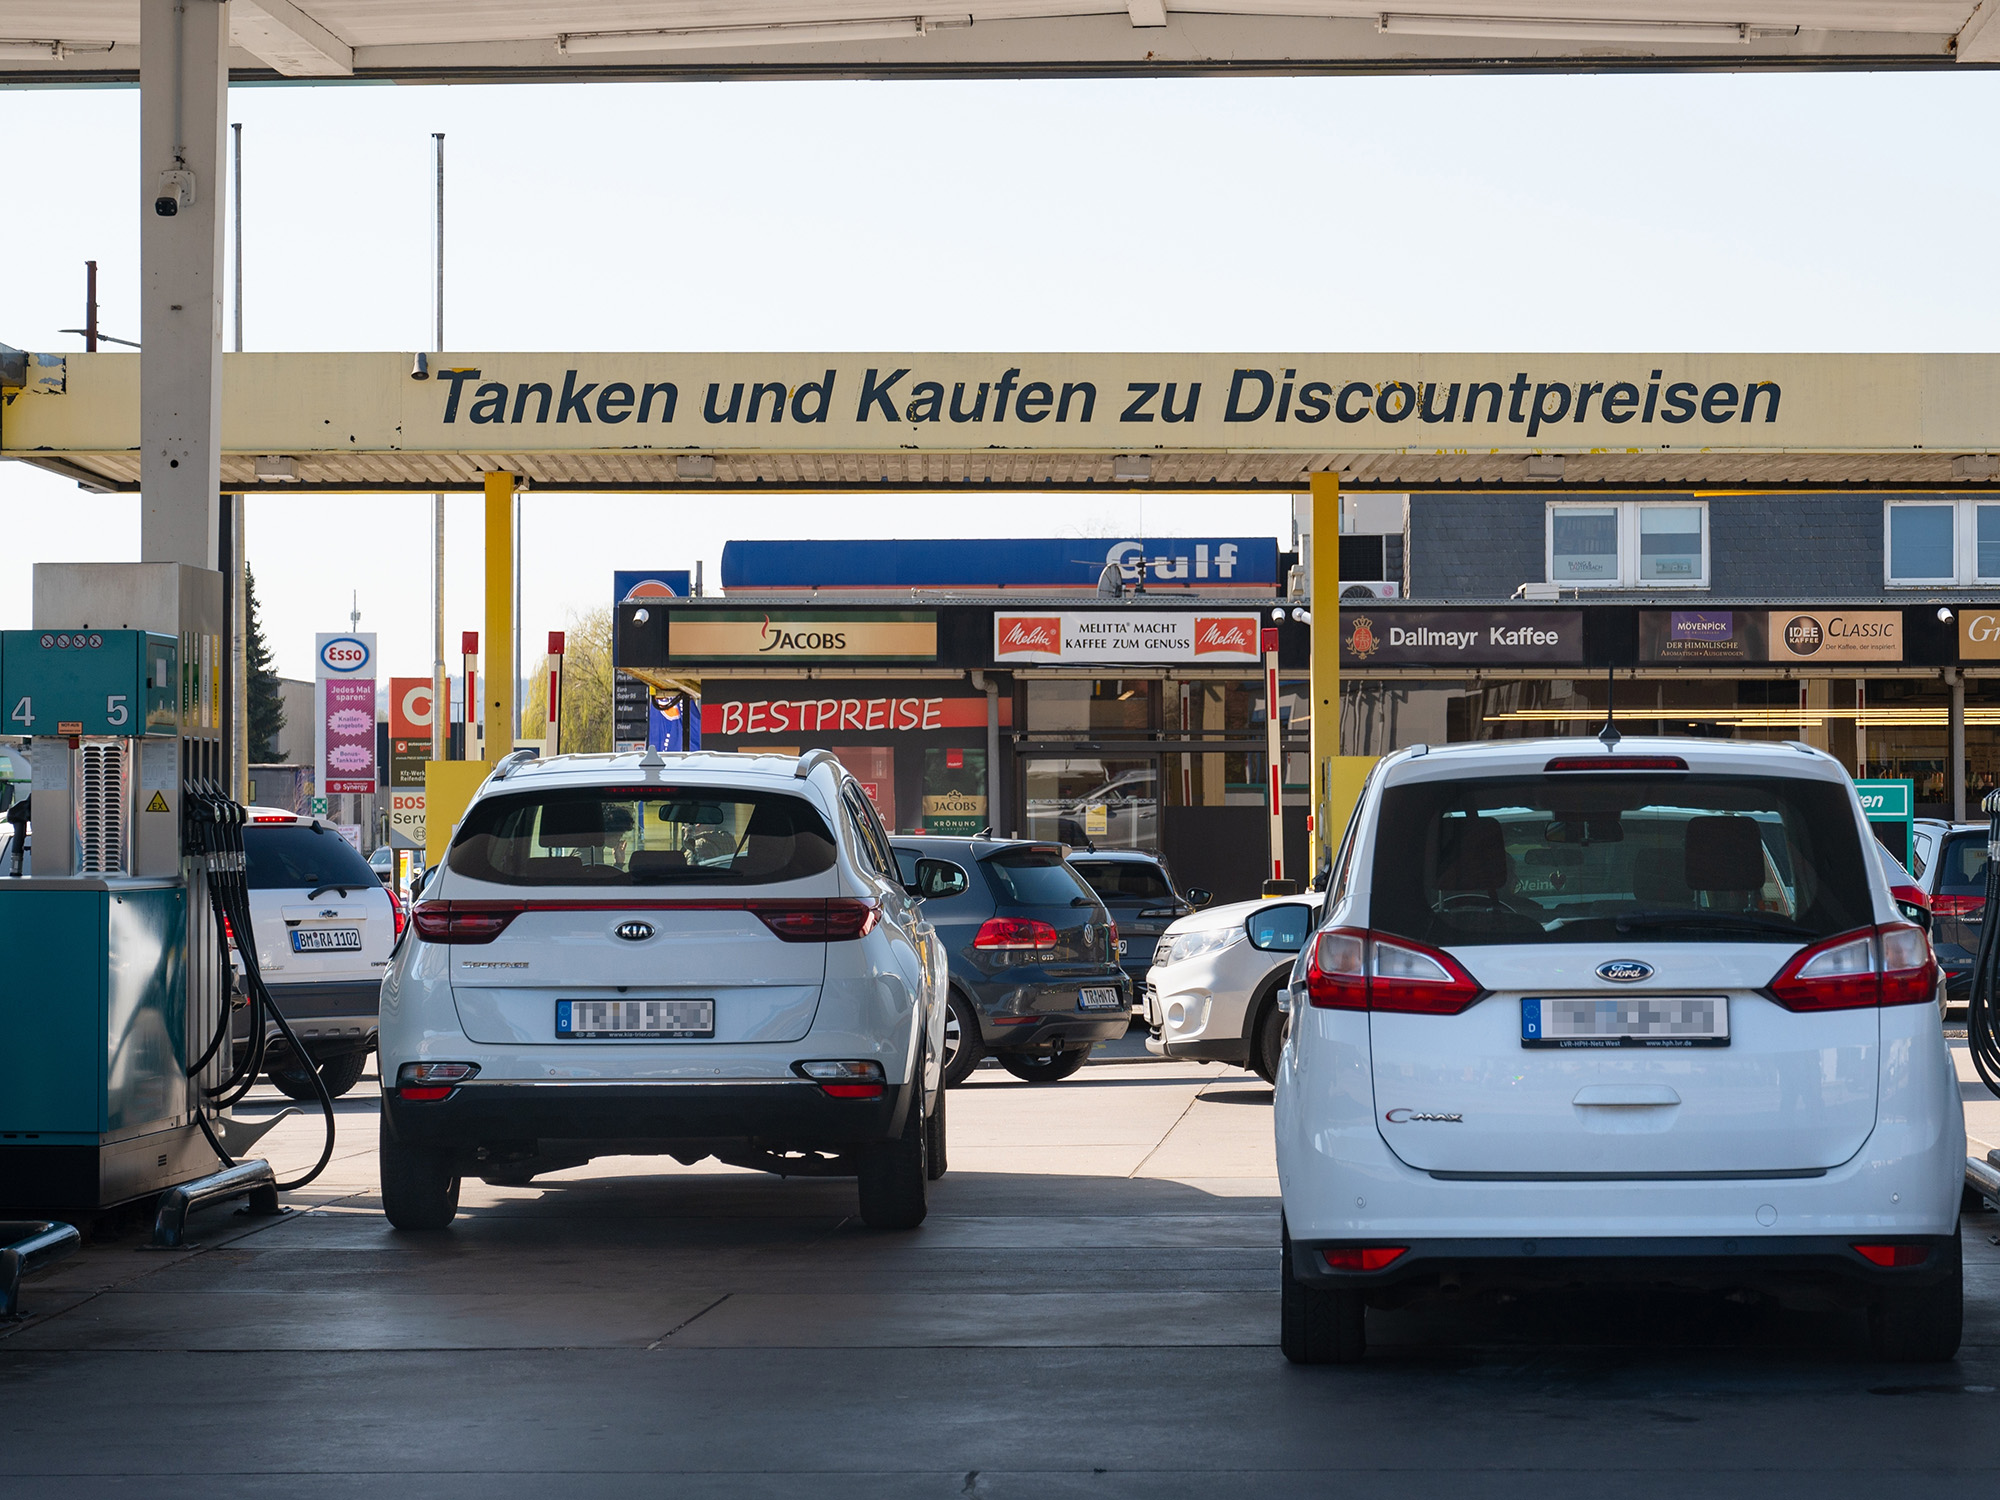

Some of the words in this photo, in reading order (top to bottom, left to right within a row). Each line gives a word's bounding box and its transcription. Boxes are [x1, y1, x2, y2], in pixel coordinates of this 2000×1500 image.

[438, 369, 678, 424] Tanken
[705, 369, 836, 424] und
[856, 369, 1096, 424] Kaufen
[1119, 383, 1199, 423] zu
[1224, 369, 1781, 437] Discountpreisen
[1106, 541, 1238, 580] Gulf
[1134, 623, 1177, 634] MACHT
[1789, 627, 1819, 637] IDEE
[1828, 617, 1895, 637] CLASSIC
[759, 629, 846, 651] JACOBS
[1065, 638, 1107, 649] KAFFEE
[1112, 638, 1141, 649] ZUM
[1144, 638, 1190, 649] GENUSS
[1390, 627, 1478, 649] Dallmayr
[1490, 627, 1559, 646] Kaffee
[328, 647, 362, 661] Esso
[331, 686, 355, 694] Jedes
[356, 686, 371, 694] Mal
[335, 694, 366, 702] sparen:
[11, 696, 36, 727] 4
[107, 695, 129, 726] 5
[721, 698, 943, 735] BESTPREISE
[342, 783, 368, 792] Synergy
[152, 802, 163, 810] EX
[393, 797, 425, 810] BOS
[933, 802, 977, 812] JACOBS
[933, 820, 976, 828] KRÖNUNG
[621, 925, 648, 937] KIA
[299, 932, 314, 947] BM
[319, 932, 334, 947] RA
[334, 931, 359, 946] 1102
[461, 961, 529, 969] SPORTAGE
[1607, 963, 1641, 980] Ford
[561, 1019, 568, 1027] D
[1528, 1023, 1536, 1033] D
